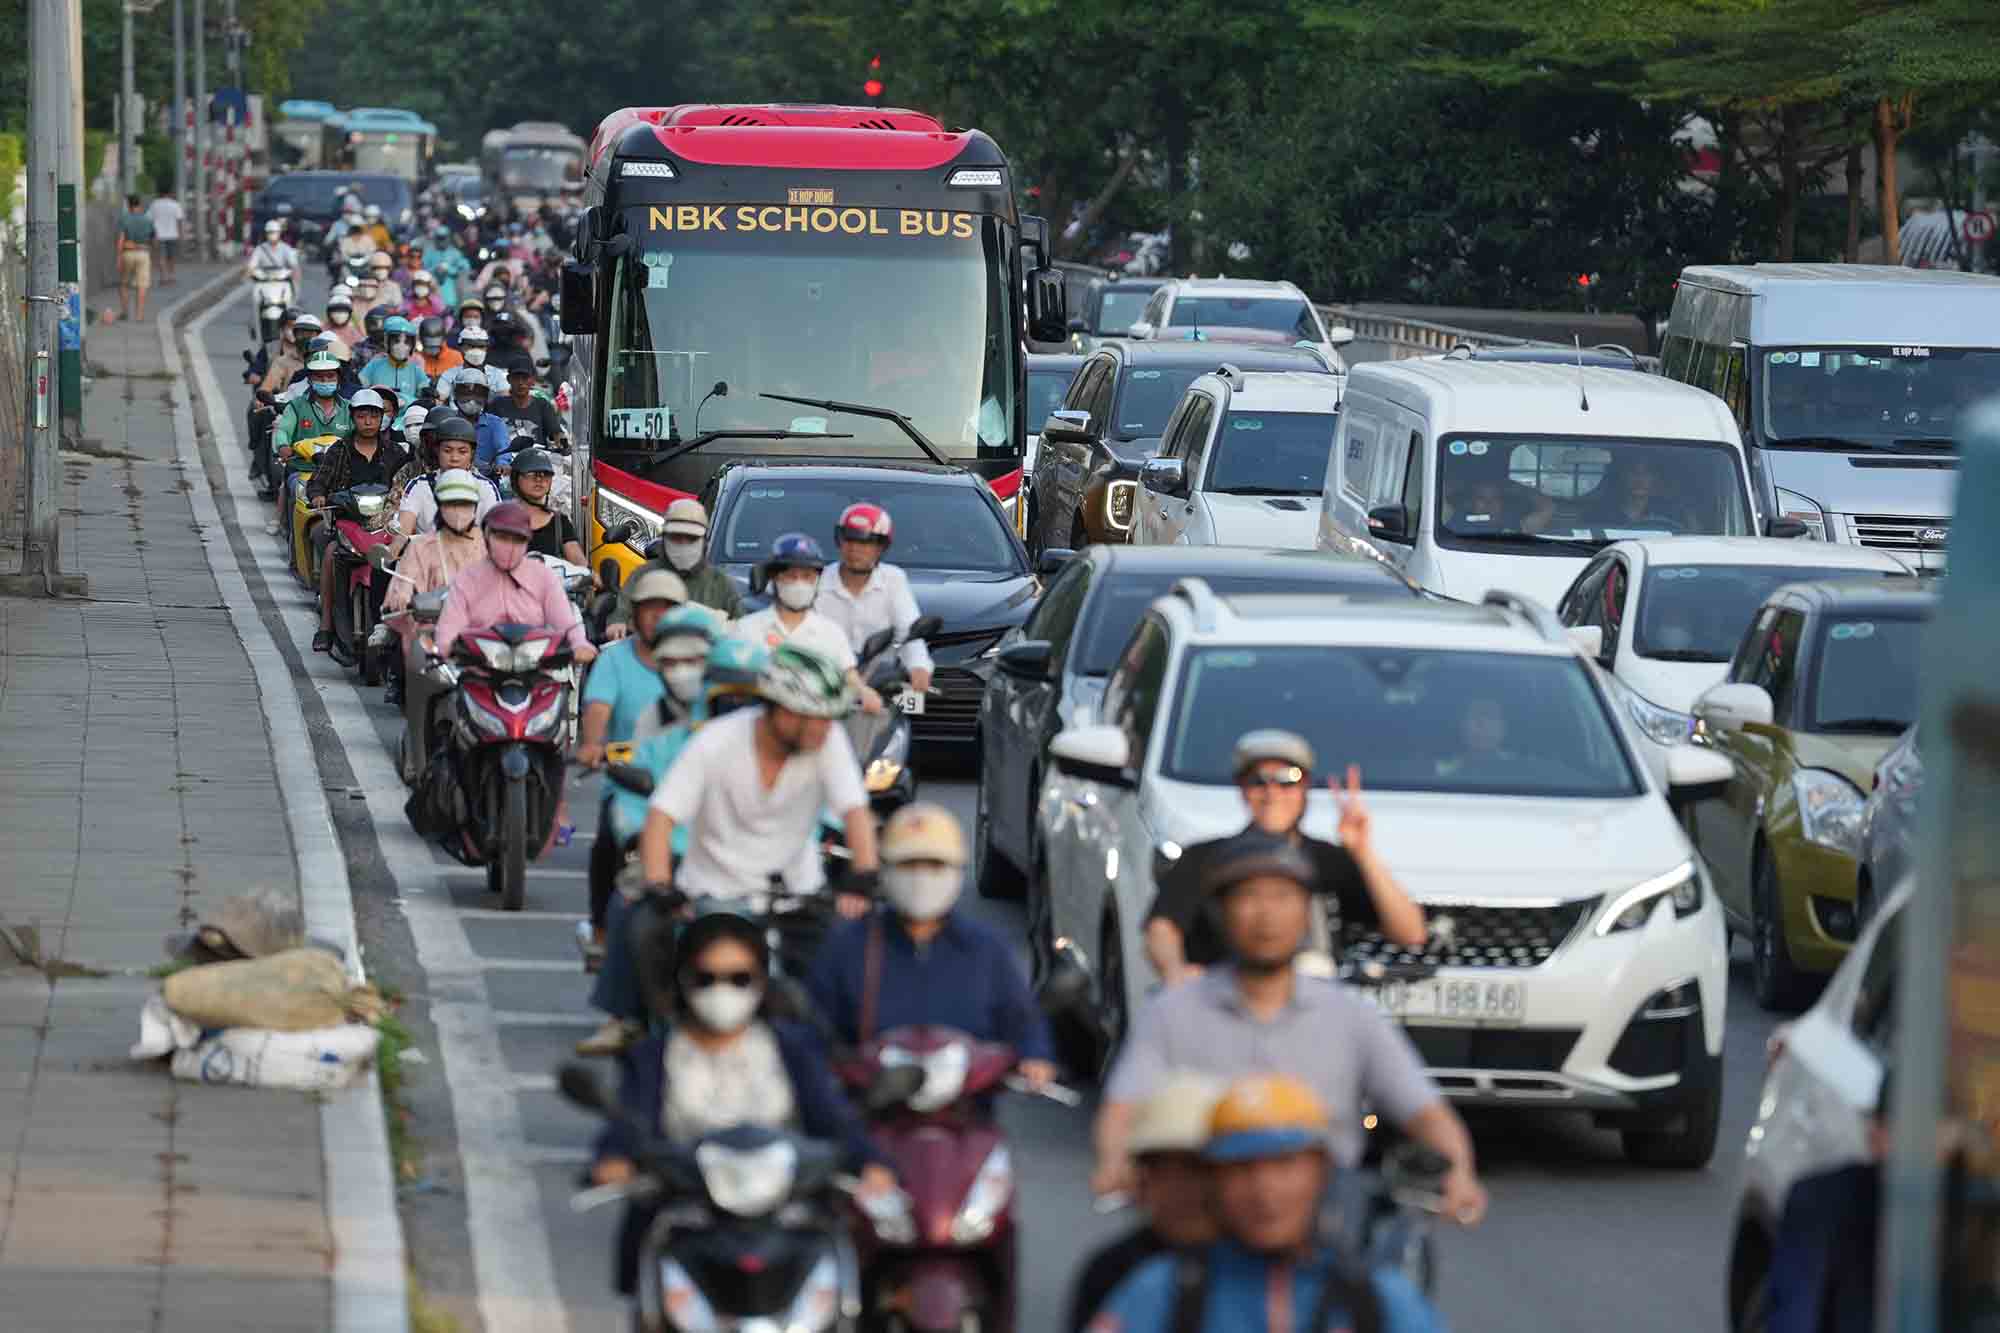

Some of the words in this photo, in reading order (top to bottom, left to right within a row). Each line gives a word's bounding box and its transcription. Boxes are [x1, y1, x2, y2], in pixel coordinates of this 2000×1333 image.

[648, 206, 727, 231] NBK
[736, 206, 888, 235] SCHOOL
[900, 209, 973, 238] BUS
[611, 413, 631, 439] PT
[644, 412, 663, 439] 50
[1924, 529, 1945, 540] Ford
